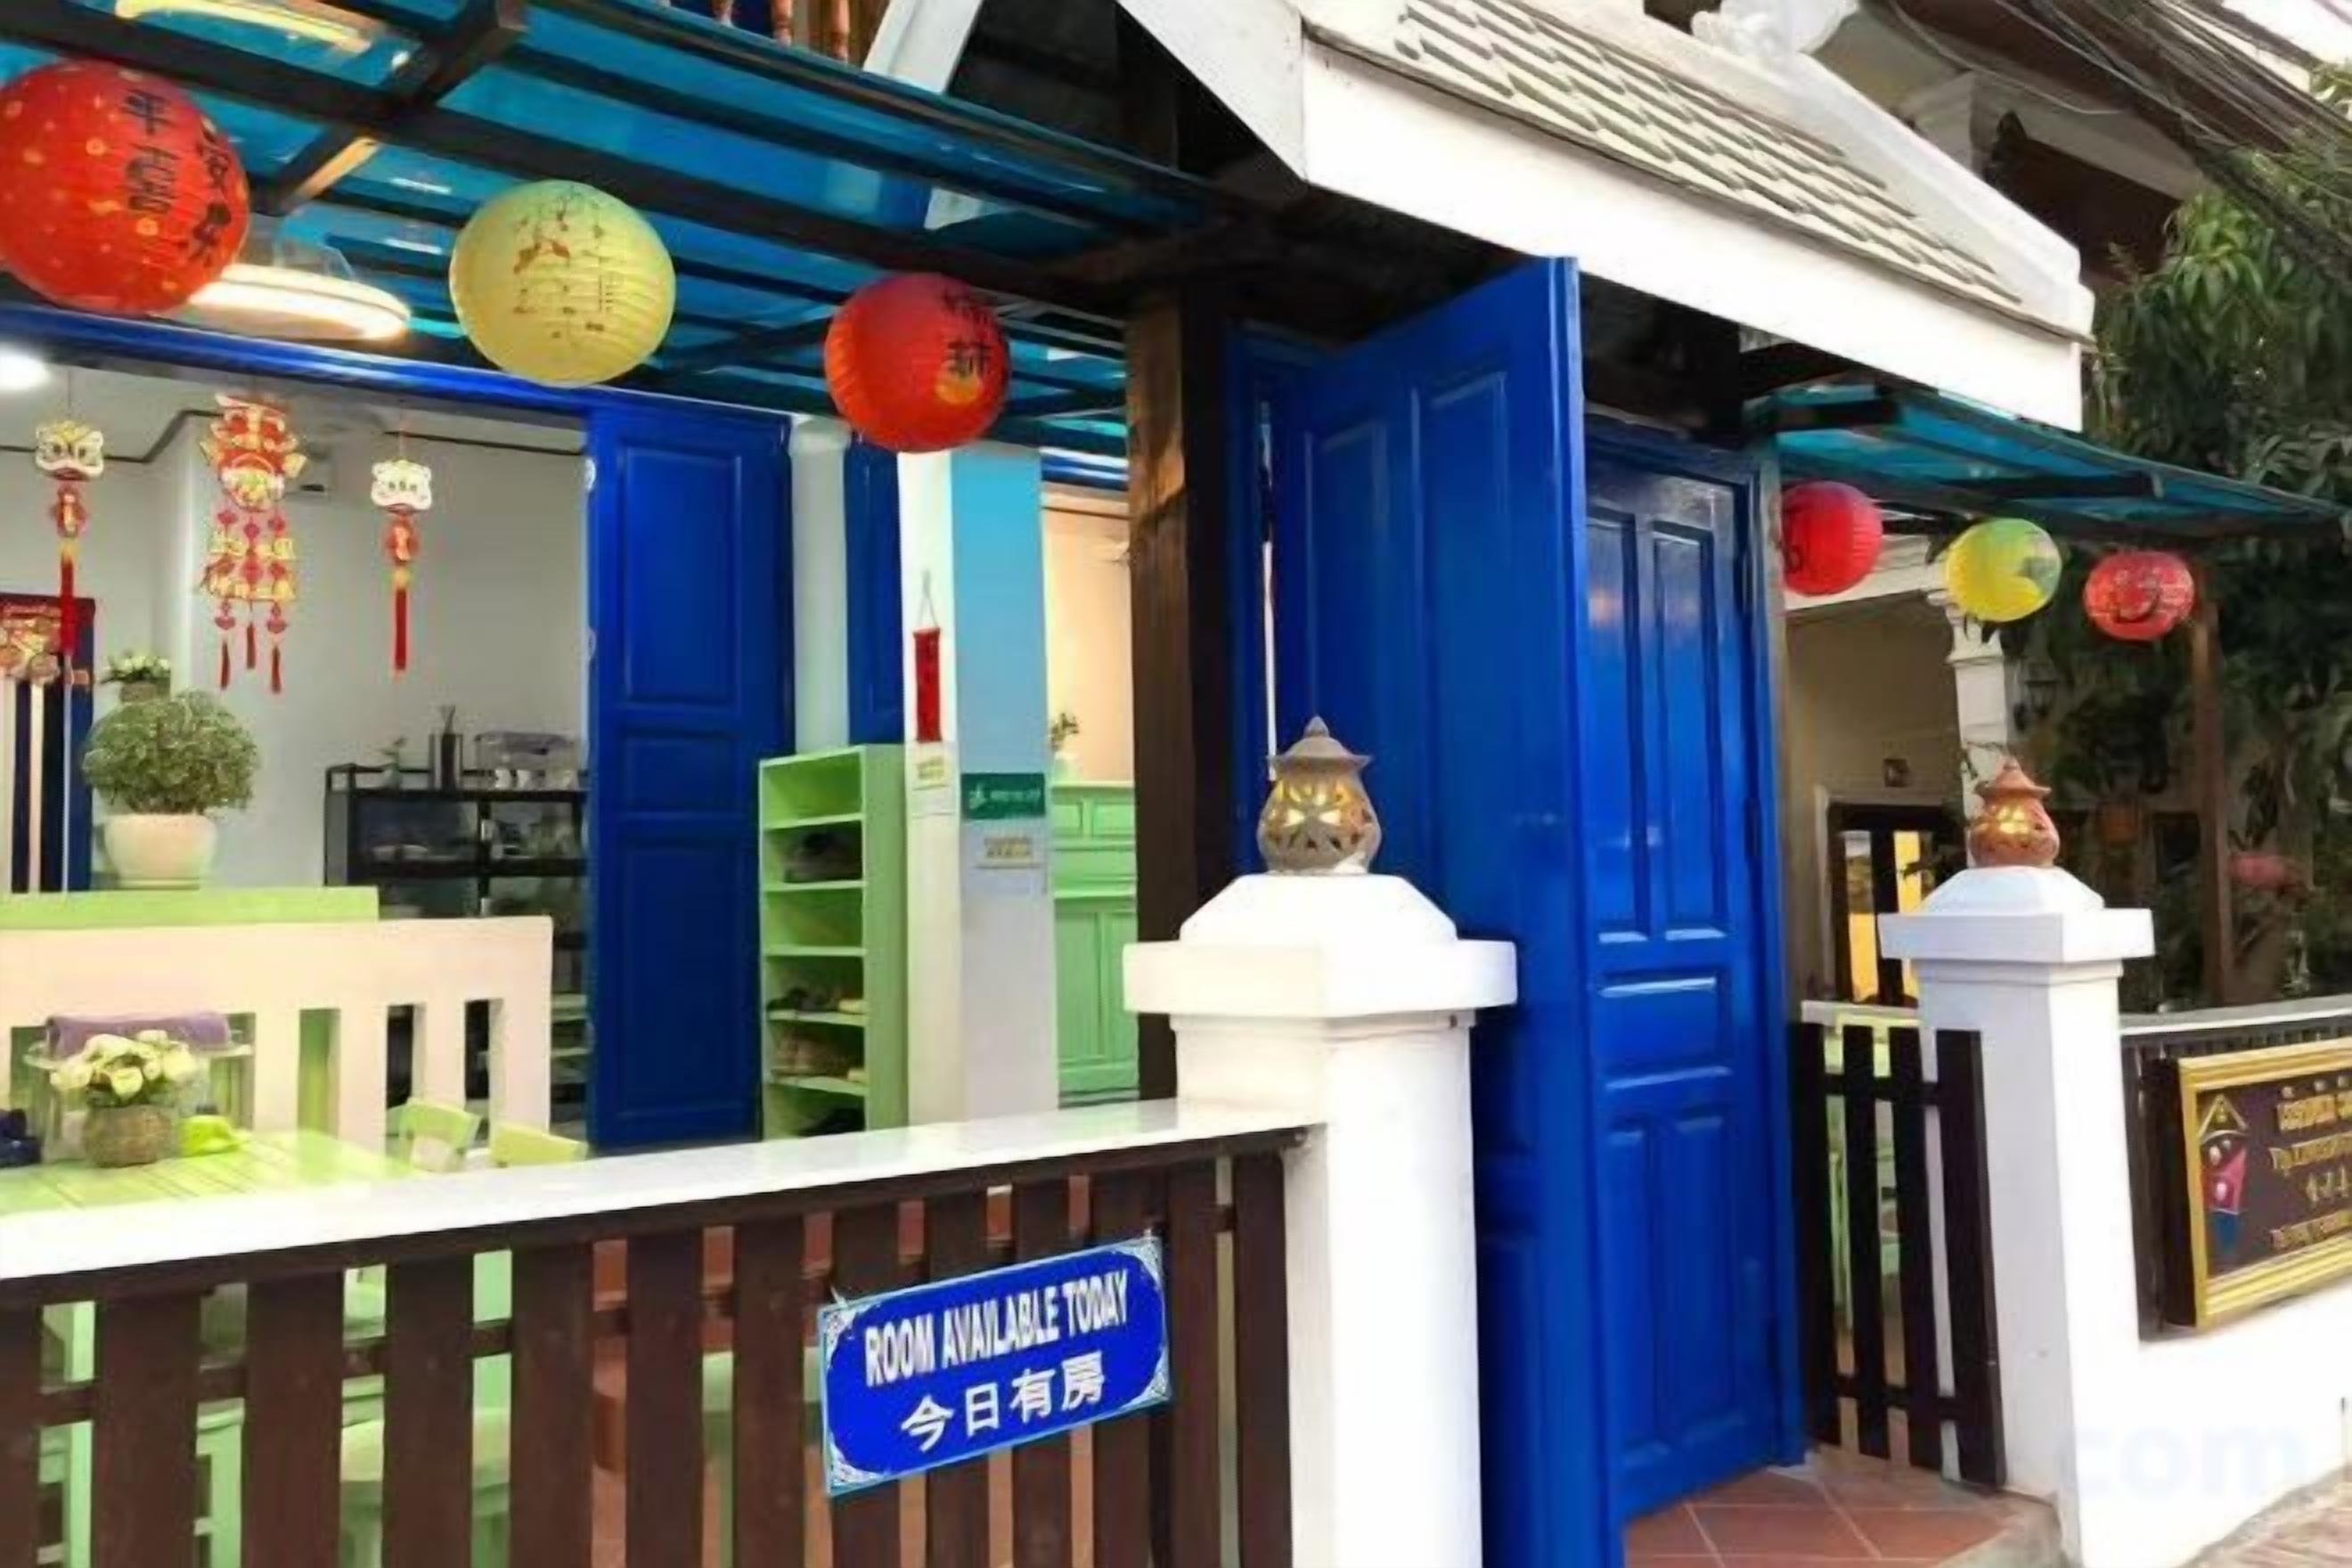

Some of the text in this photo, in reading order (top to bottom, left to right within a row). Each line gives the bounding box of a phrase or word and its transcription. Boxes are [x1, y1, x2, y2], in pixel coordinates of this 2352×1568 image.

[865, 1270, 1129, 1387] ROOM AVAILABLE TODAY
[901, 1352, 1106, 1452] 今日有房
